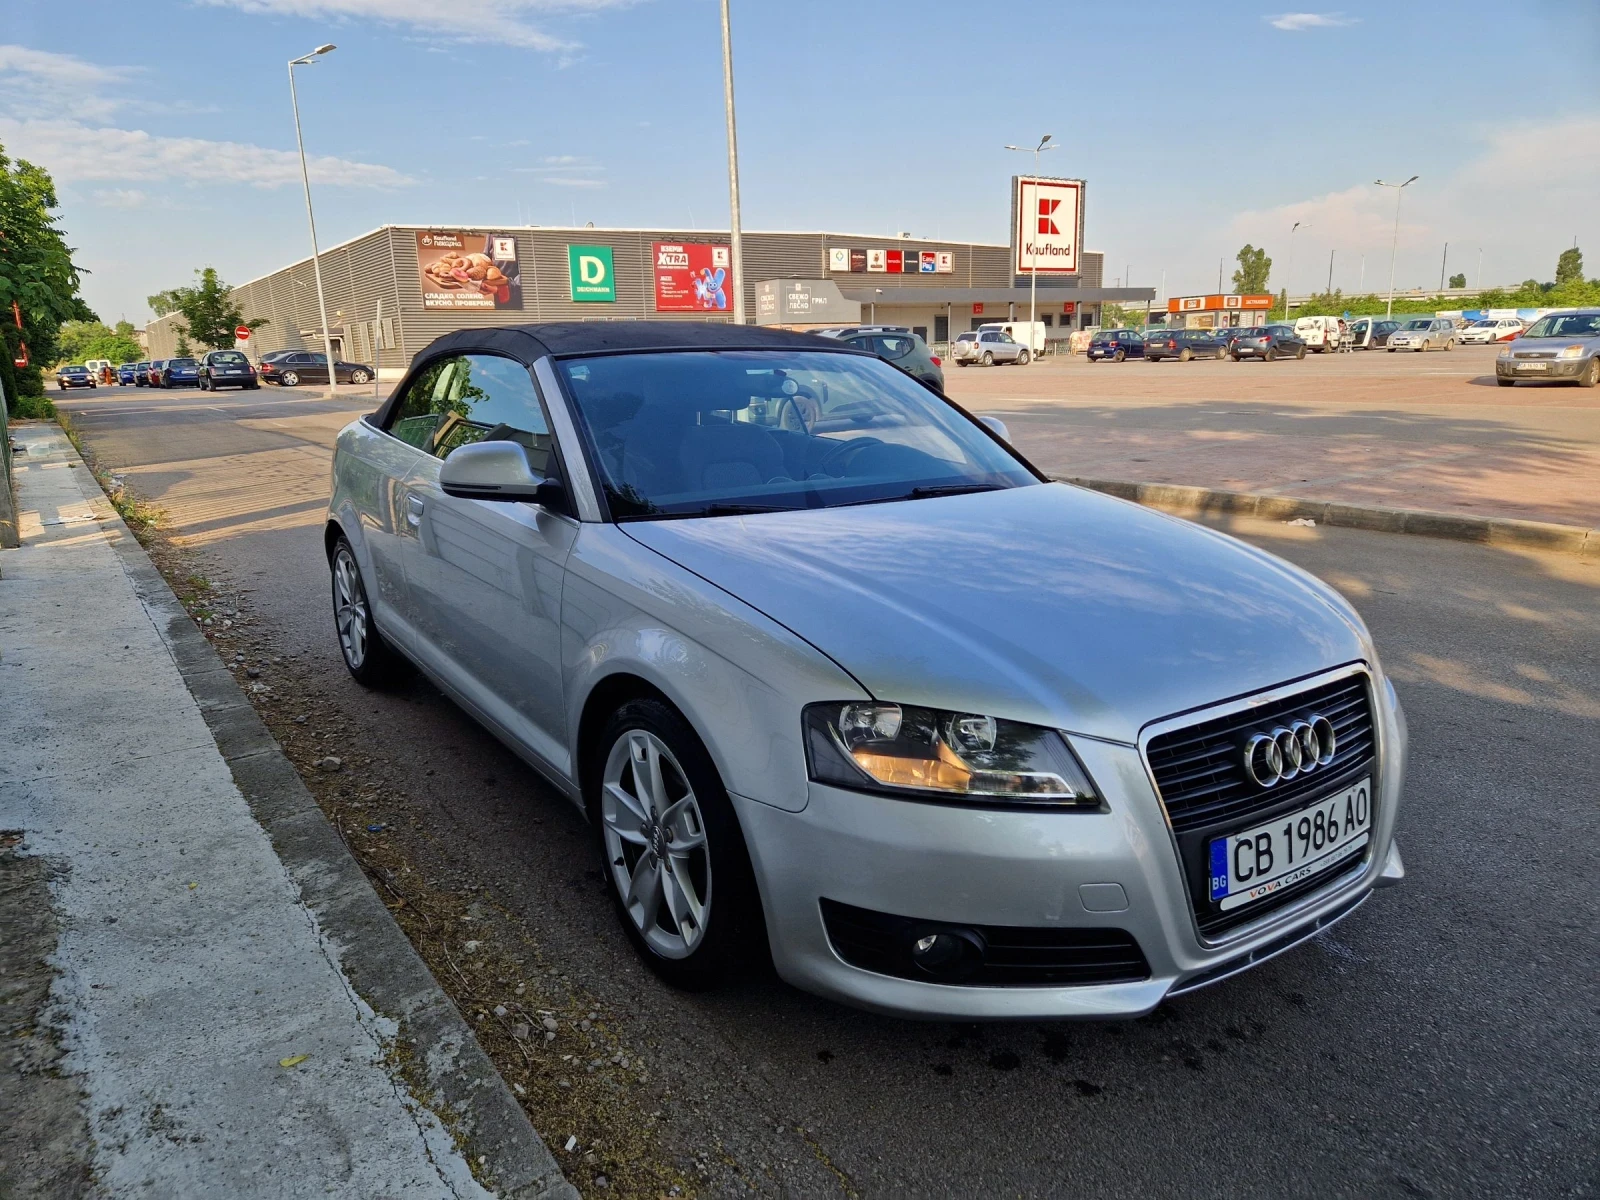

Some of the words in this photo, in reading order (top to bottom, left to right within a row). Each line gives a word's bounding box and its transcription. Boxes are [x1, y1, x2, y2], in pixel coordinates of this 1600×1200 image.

[1026, 243, 1070, 256] Kaufland
[580, 255, 605, 284] D
[1234, 832, 1273, 882] CB
[1284, 803, 1339, 865] 1986
[1344, 787, 1367, 836] AO
[1212, 875, 1226, 891] BG
[1249, 882, 1282, 899] VOVA
[1285, 866, 1312, 884] CARS
